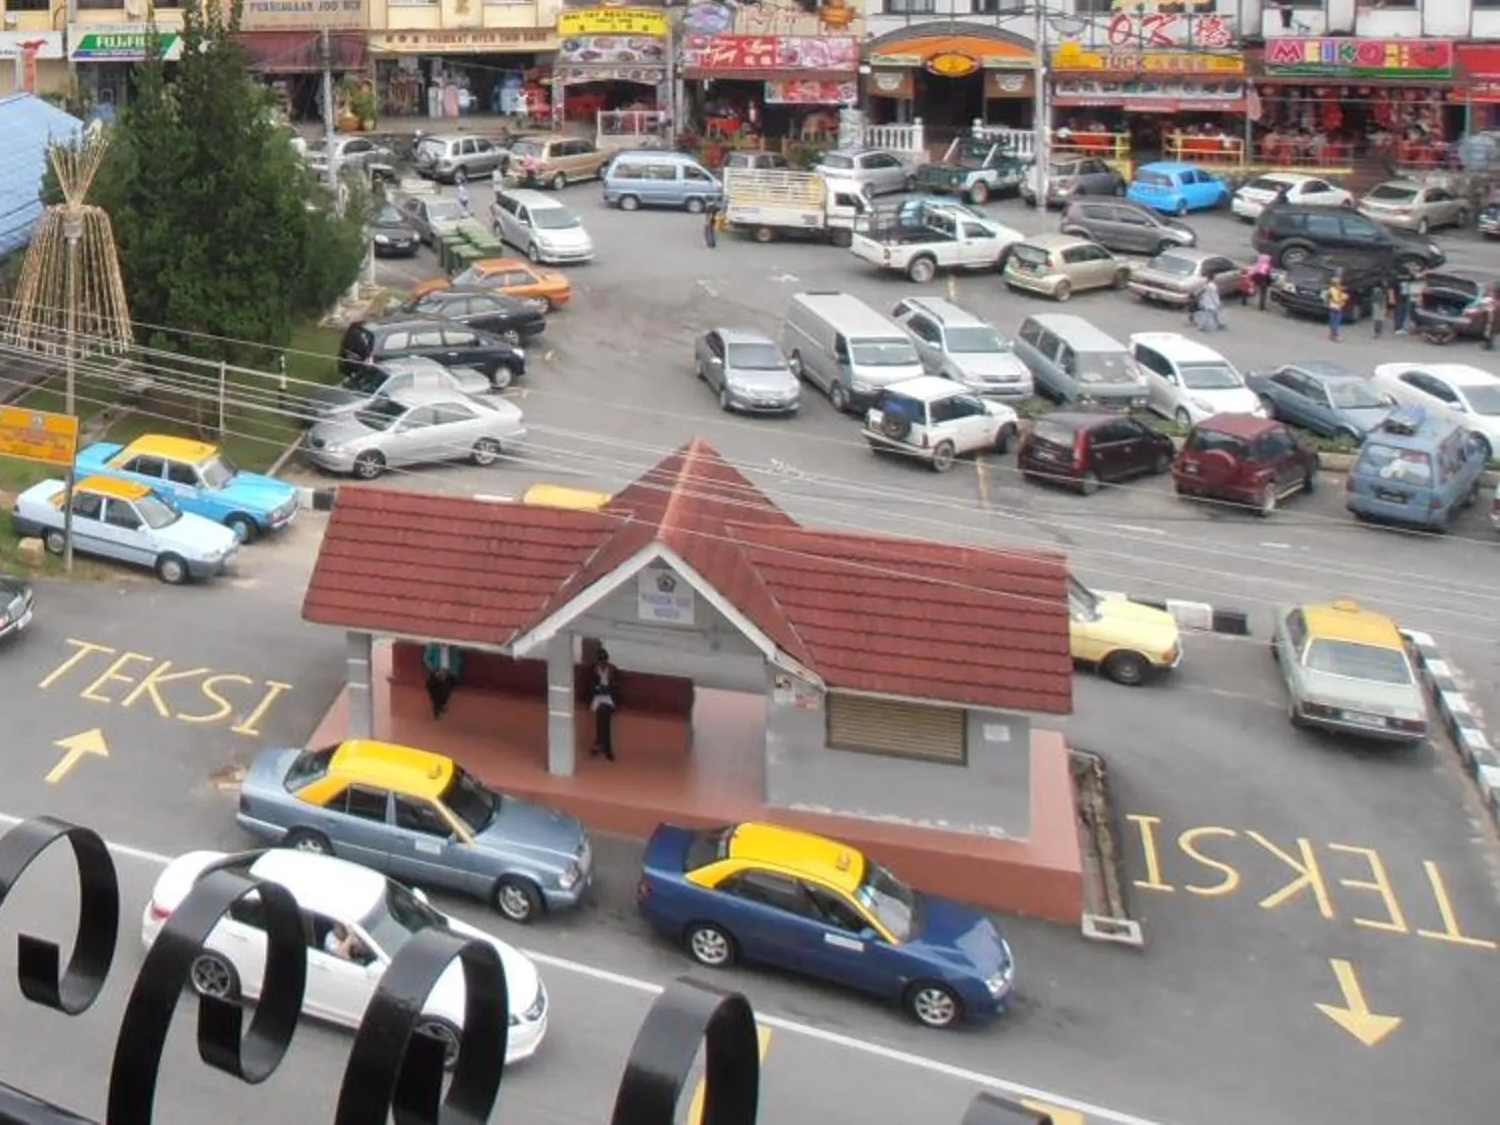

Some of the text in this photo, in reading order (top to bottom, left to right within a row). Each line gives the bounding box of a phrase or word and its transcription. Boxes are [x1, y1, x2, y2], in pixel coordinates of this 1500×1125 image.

[1107, 12, 1179, 46] OK
[38, 638, 294, 736] TEKSI
[1125, 813, 1498, 949] TEKSI
